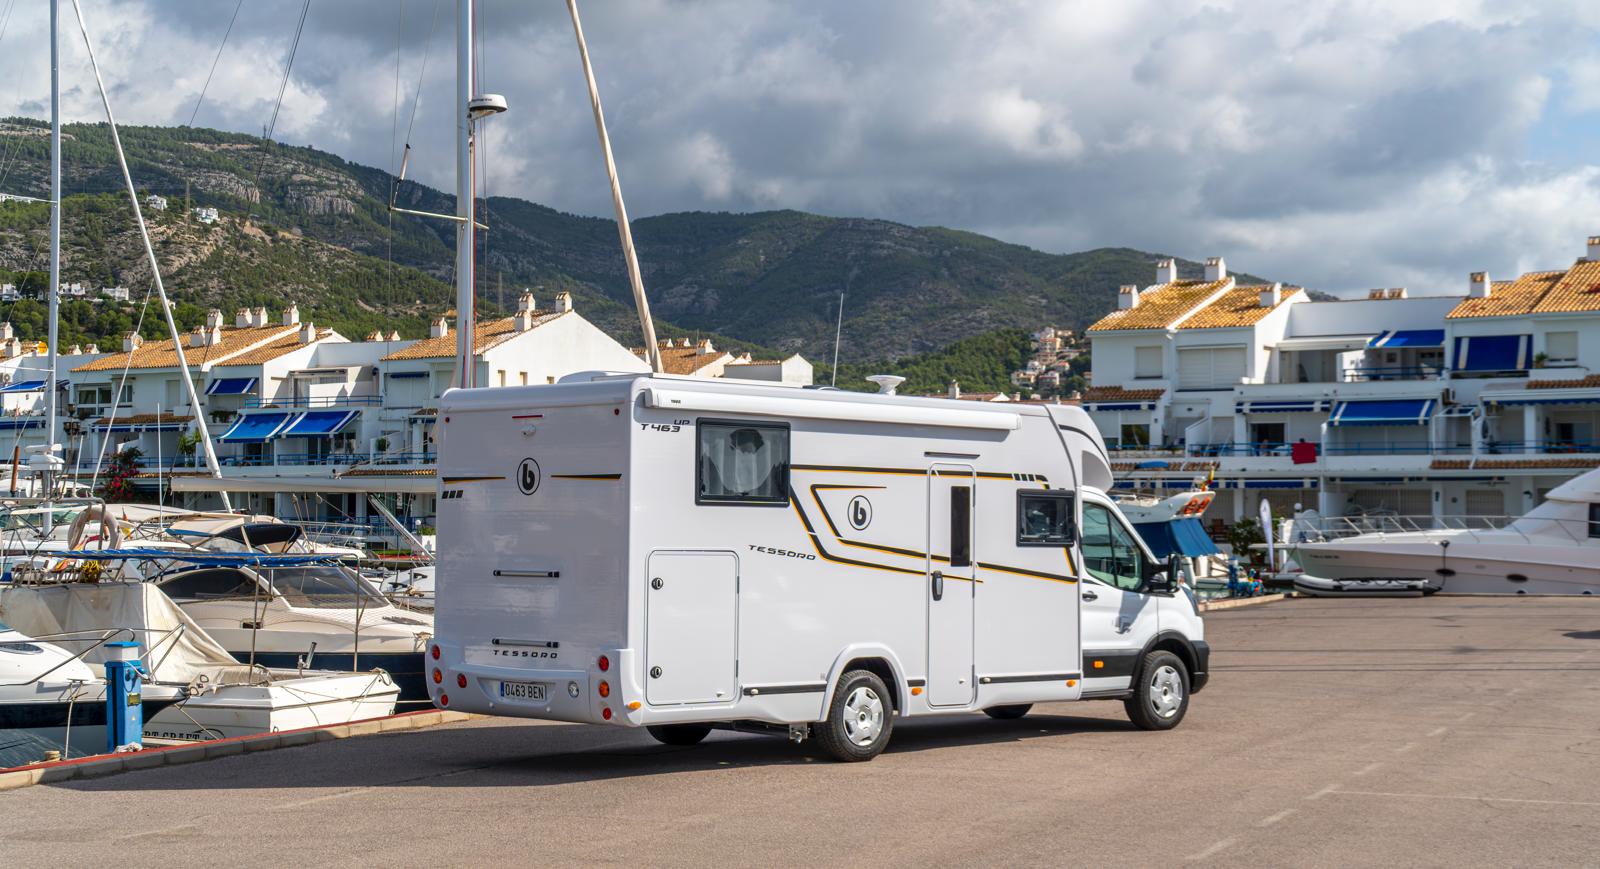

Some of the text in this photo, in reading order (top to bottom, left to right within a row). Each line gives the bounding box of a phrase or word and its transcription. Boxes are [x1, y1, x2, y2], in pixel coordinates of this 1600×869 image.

[748, 545, 816, 561] TESSORO
[493, 650, 558, 659] TESSORO
[505, 684, 544, 699] 0463 BEN
